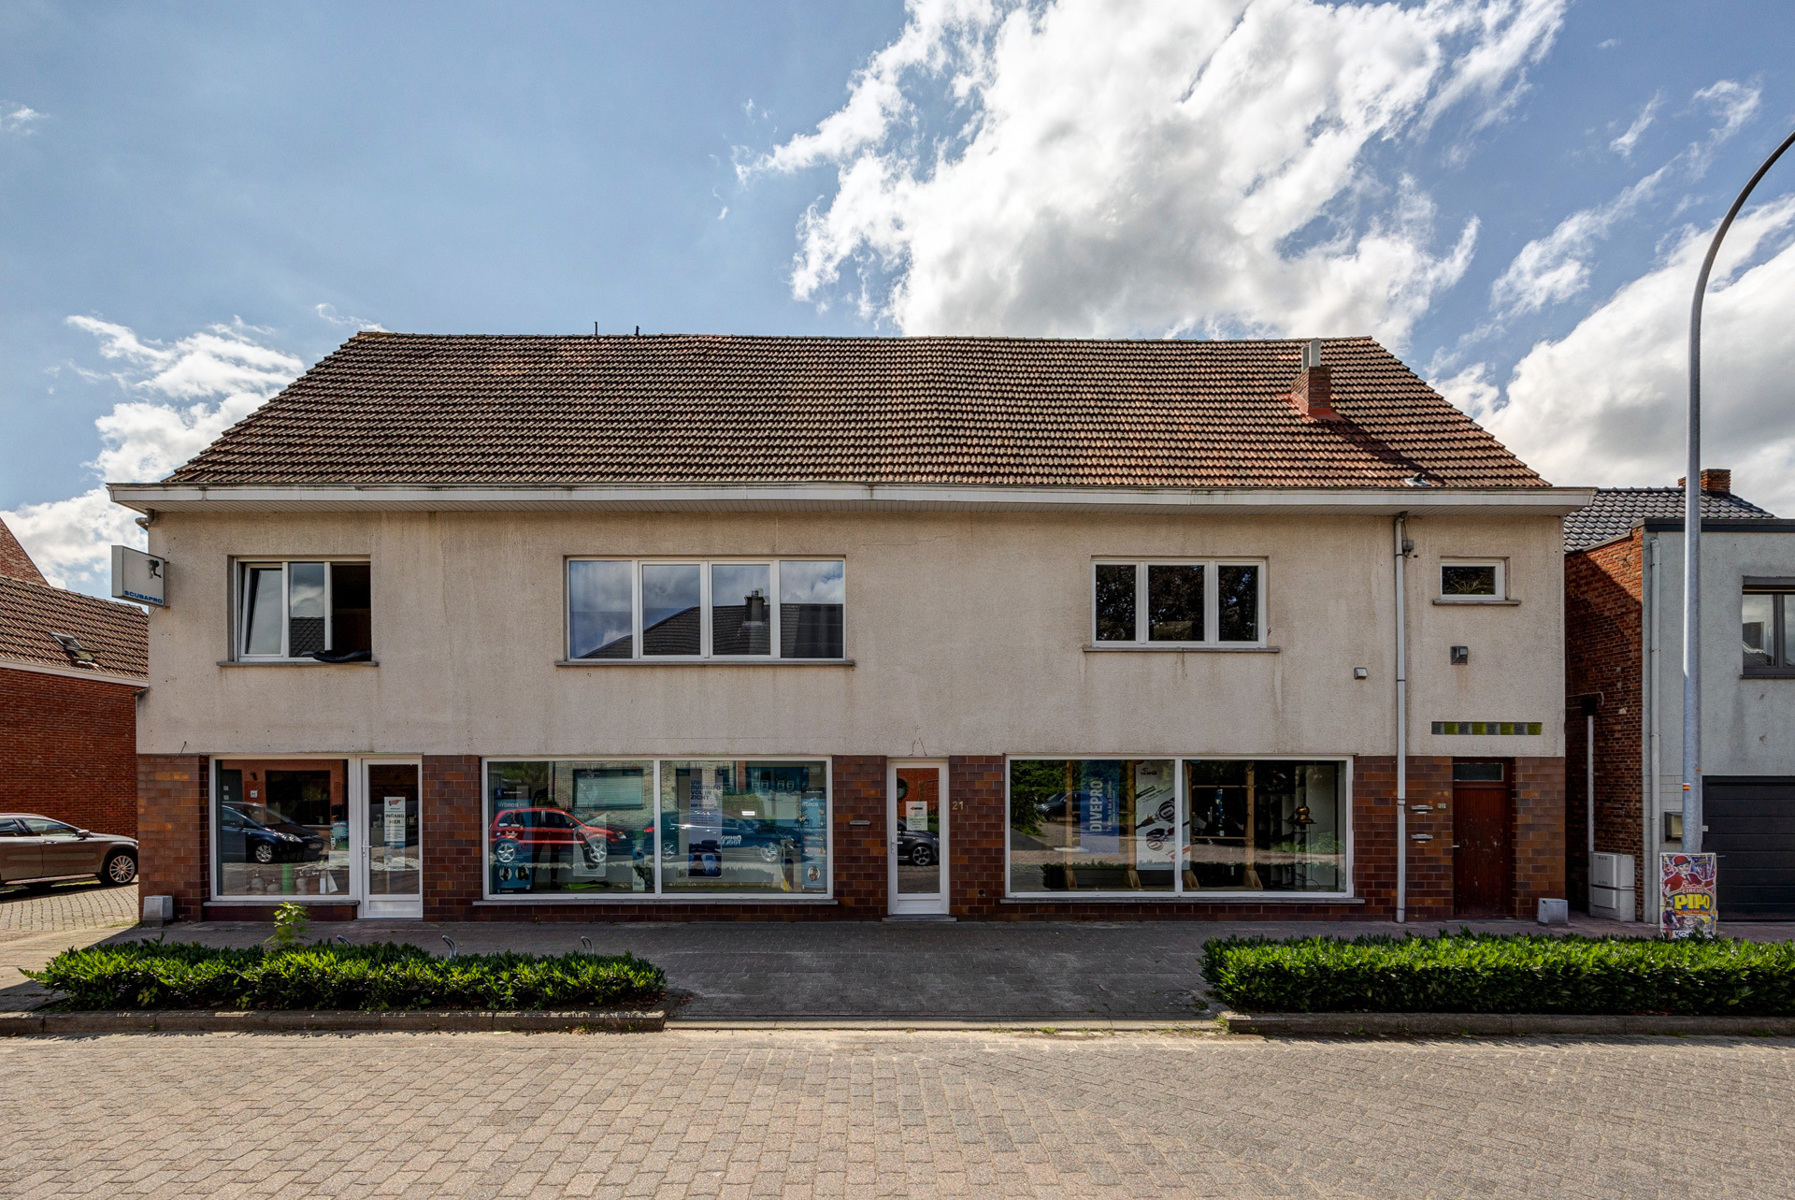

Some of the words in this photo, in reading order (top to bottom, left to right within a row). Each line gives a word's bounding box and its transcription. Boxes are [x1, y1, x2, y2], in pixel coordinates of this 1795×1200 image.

[124, 590, 163, 604] SCUBAPRO
[951, 800, 964, 811] 21
[1090, 781, 1103, 832] DIVEPRO
[1674, 894, 1710, 909] PIPO
